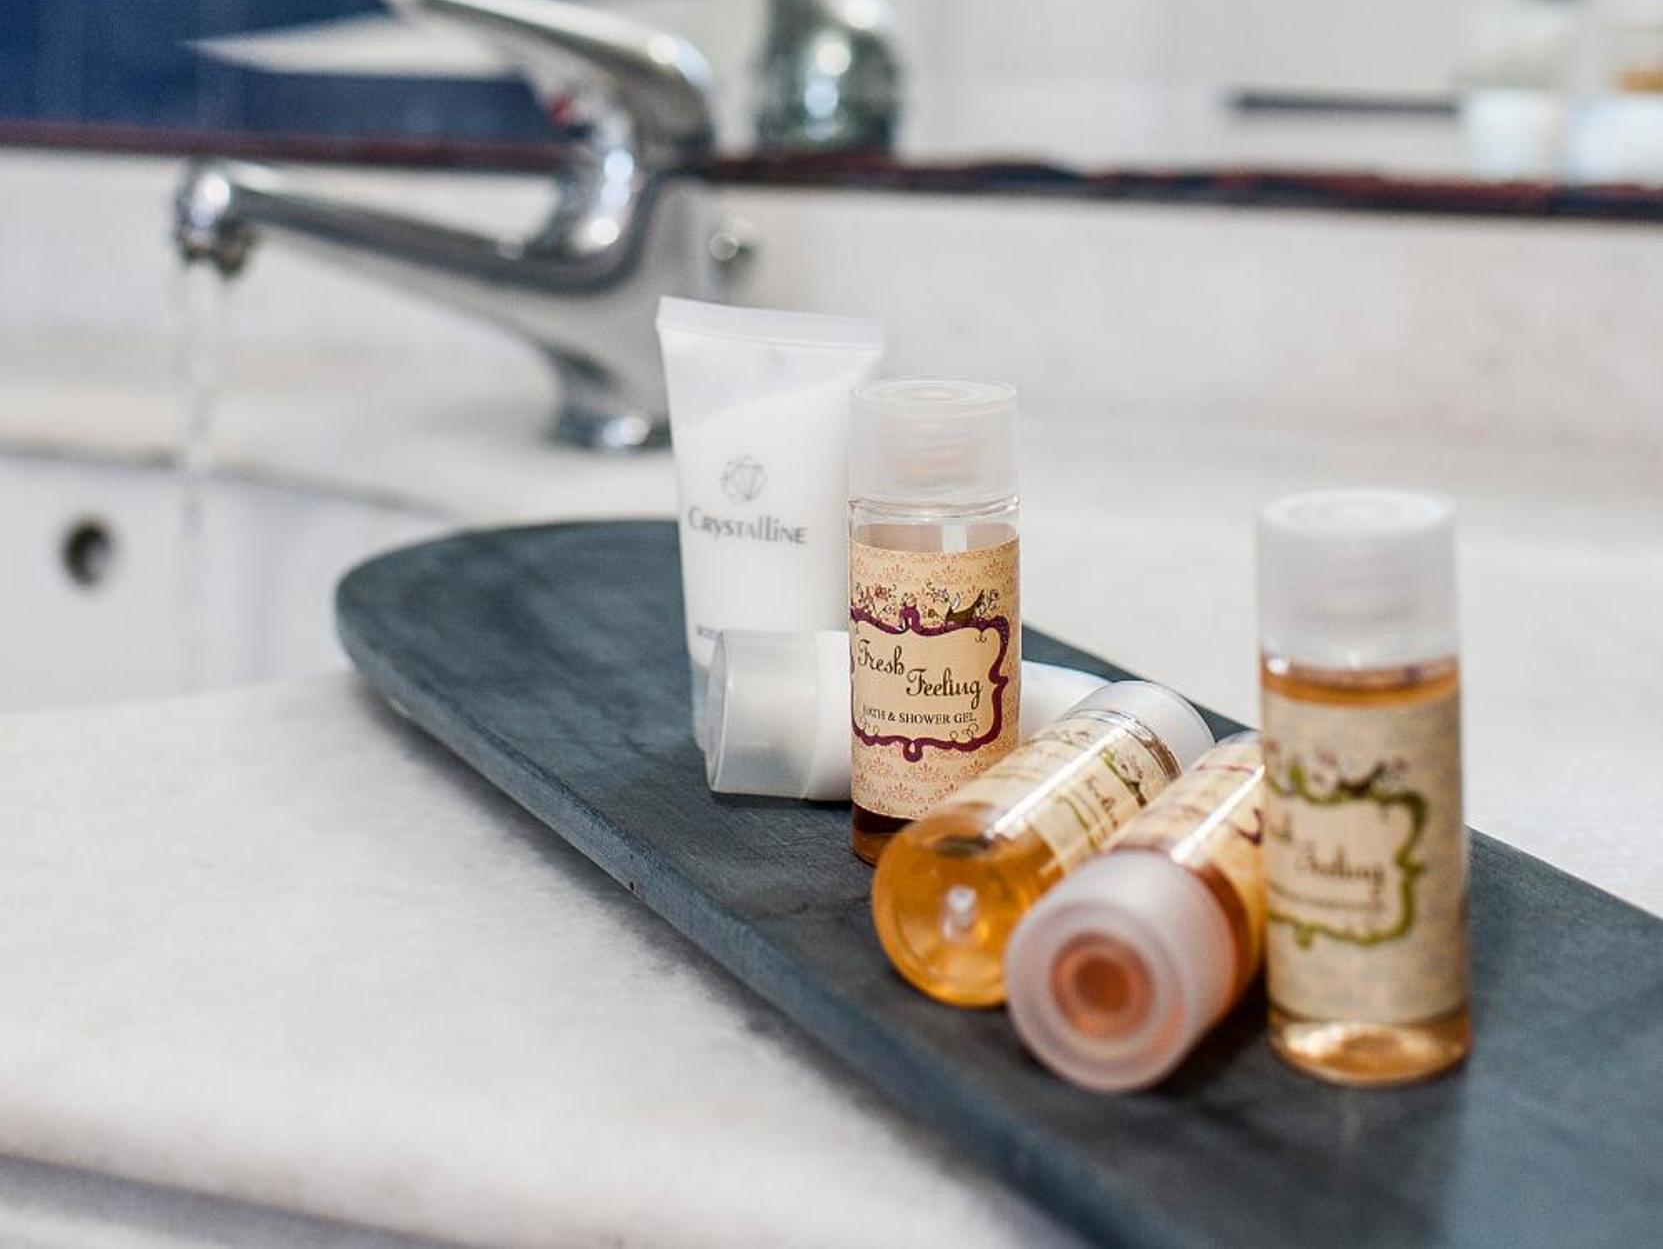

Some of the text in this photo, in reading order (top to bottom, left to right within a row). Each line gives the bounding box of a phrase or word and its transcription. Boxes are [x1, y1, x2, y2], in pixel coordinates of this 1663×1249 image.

[857, 638, 904, 675] Fresh
[906, 667, 982, 710] Feeling
[887, 711, 896, 722] &
[899, 712, 950, 725] SHOWER
[954, 712, 977, 724] GEL
